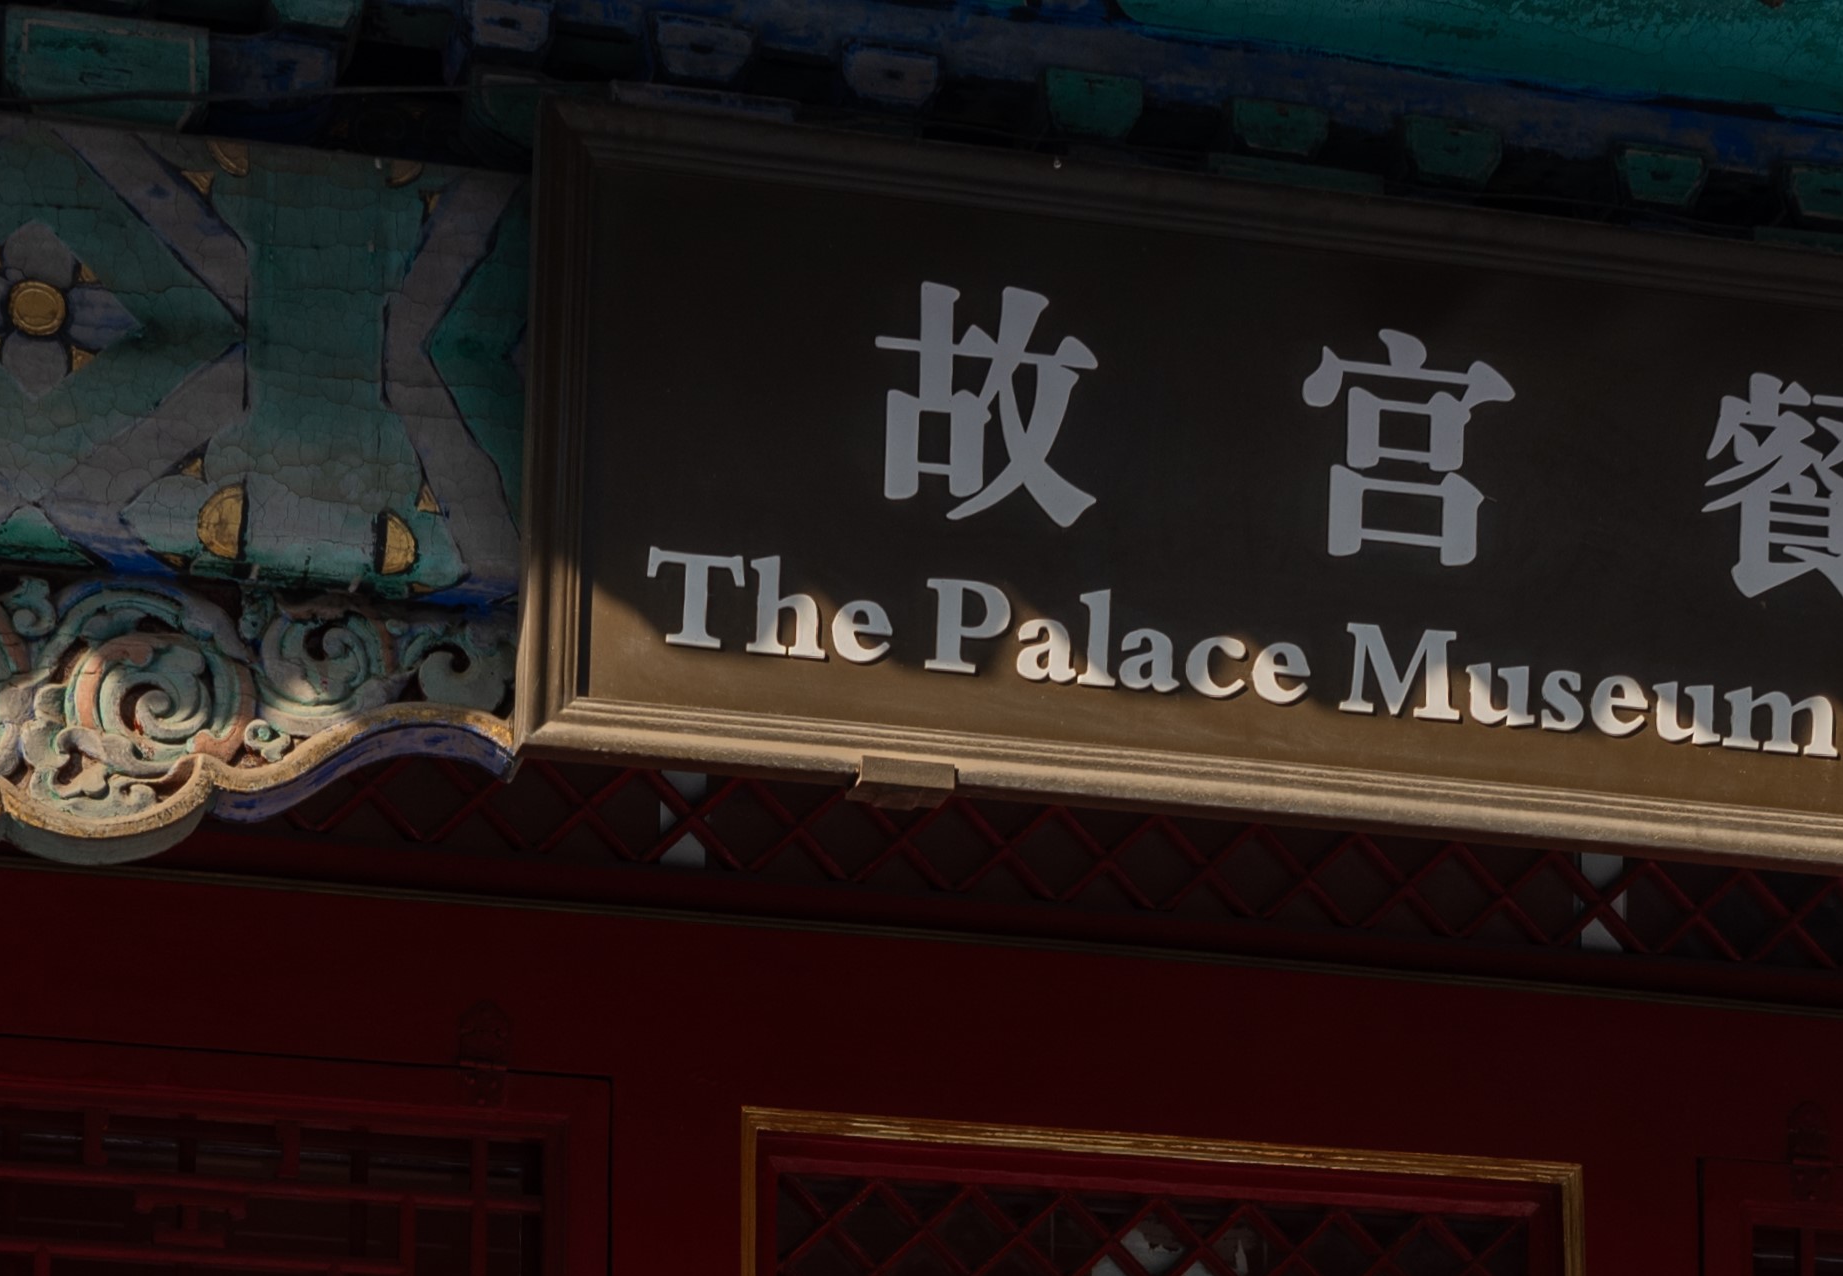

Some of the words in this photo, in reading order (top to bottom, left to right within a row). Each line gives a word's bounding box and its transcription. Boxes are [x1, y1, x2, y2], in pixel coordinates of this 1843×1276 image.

[647, 545, 894, 663] The
[925, 577, 1312, 706] Palace
[1338, 622, 1840, 759] Museum
